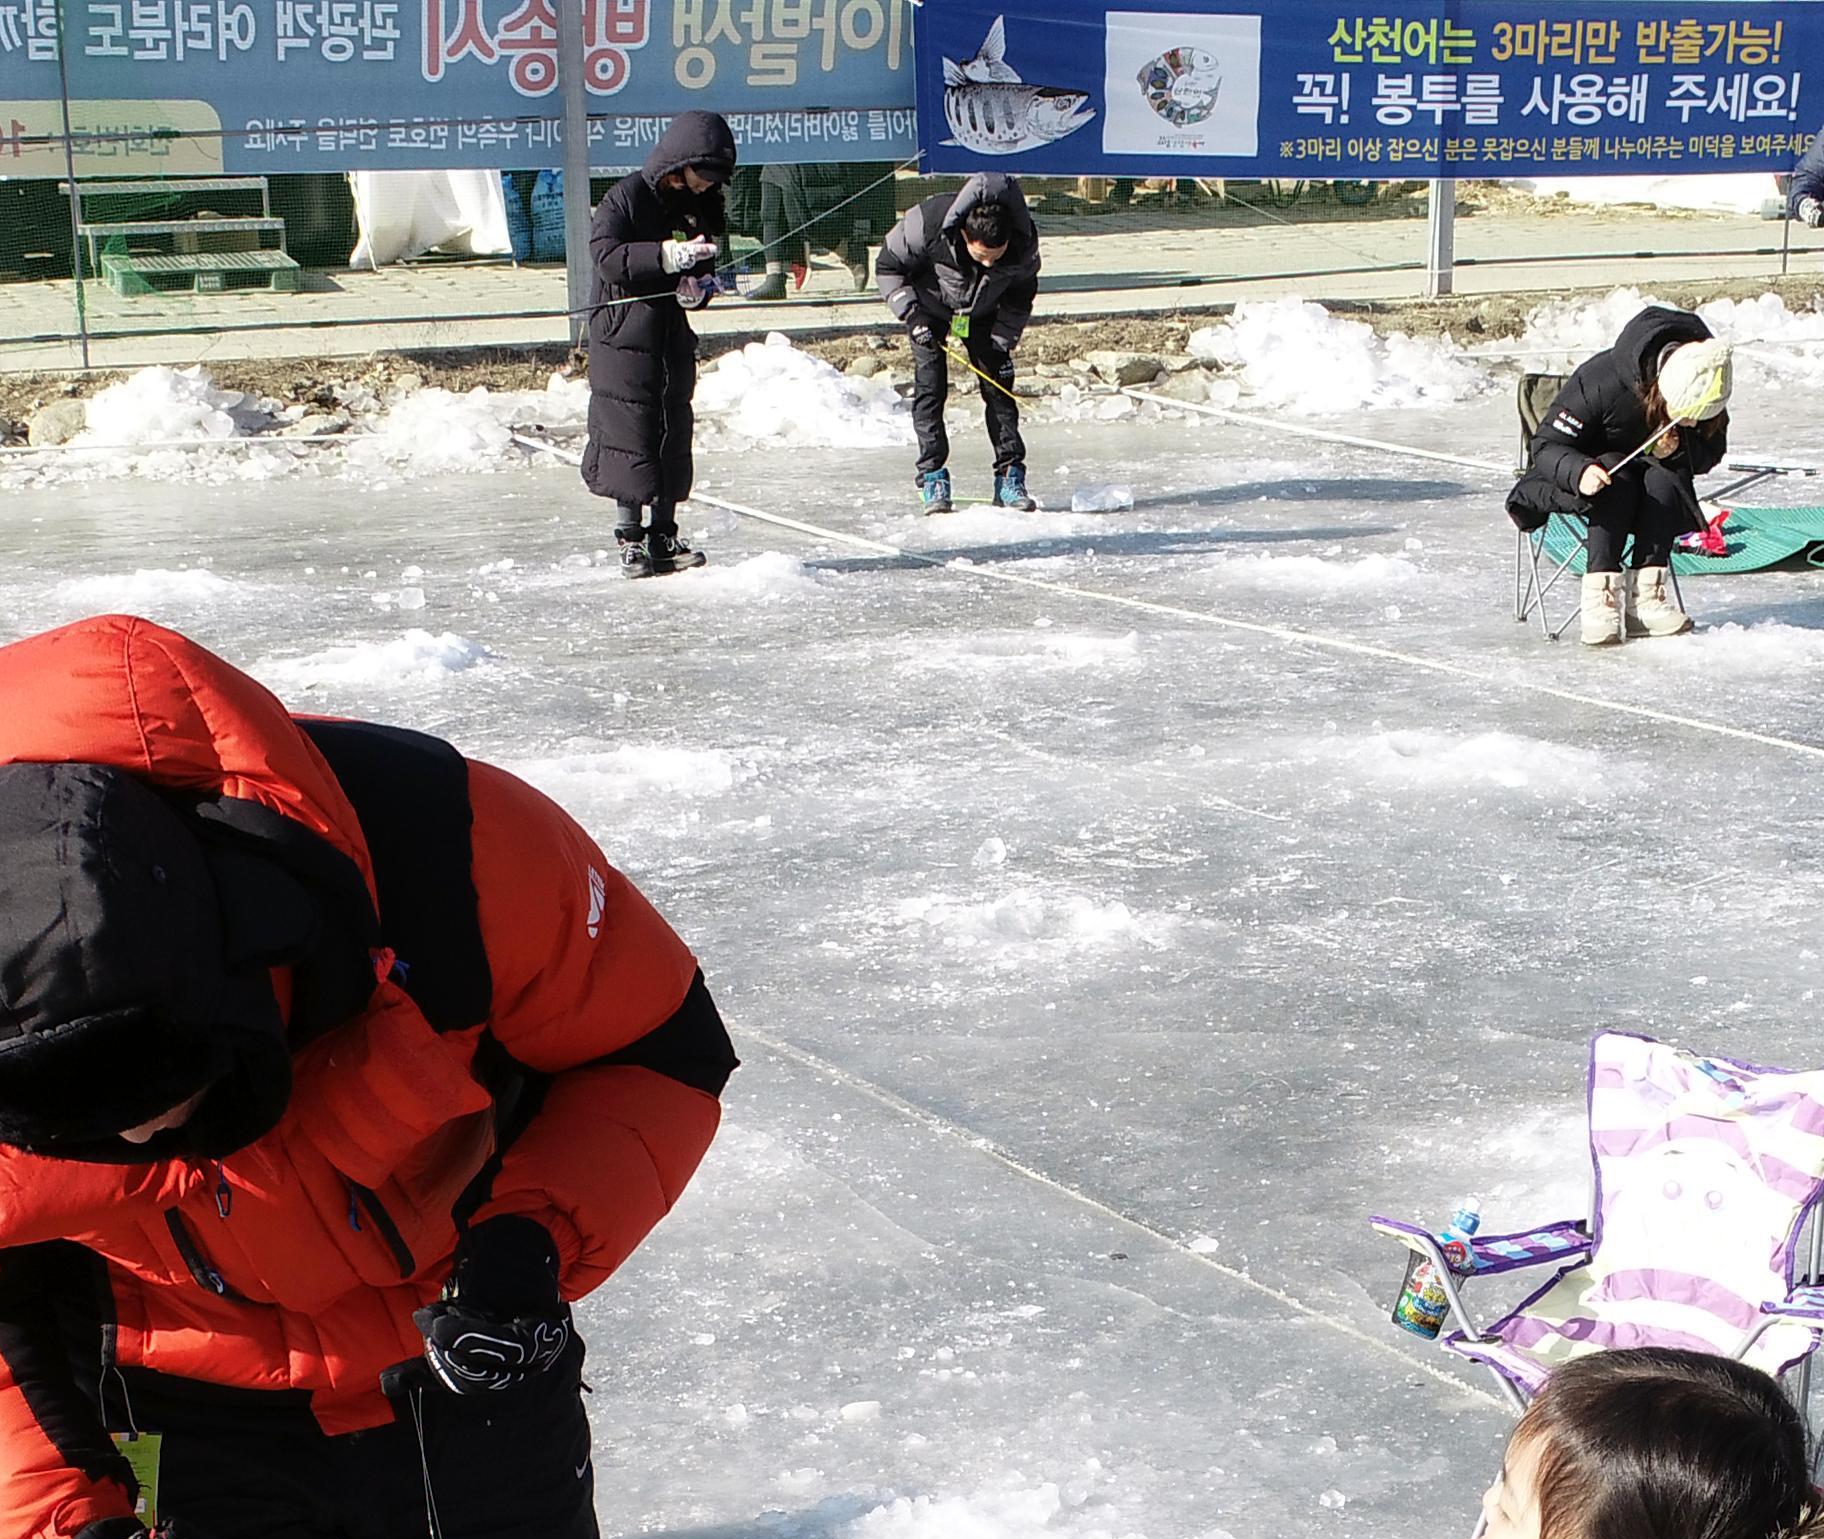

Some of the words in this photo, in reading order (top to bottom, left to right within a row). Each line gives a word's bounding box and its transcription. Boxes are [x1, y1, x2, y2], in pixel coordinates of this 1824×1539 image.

[1326, 15, 1478, 66] 산천어는
[1490, 20, 1621, 66] 3마리만
[1635, 19, 1783, 66] 반출가능!
[1291, 72, 1351, 127] 꼭!
[1370, 72, 1505, 126] 봉투를
[1519, 72, 1647, 126] 사용해
[1664, 72, 1802, 123] 주세요!
[1347, 136, 1383, 162] 이상
[1387, 137, 1440, 162] 잡으신
[1443, 138, 1478, 161] 분은
[1481, 137, 1547, 162] 못잡으신
[1551, 135, 1600, 160] 분들께
[1604, 135, 1685, 160] 나누어주는
[1688, 134, 1737, 159] 미덕을
